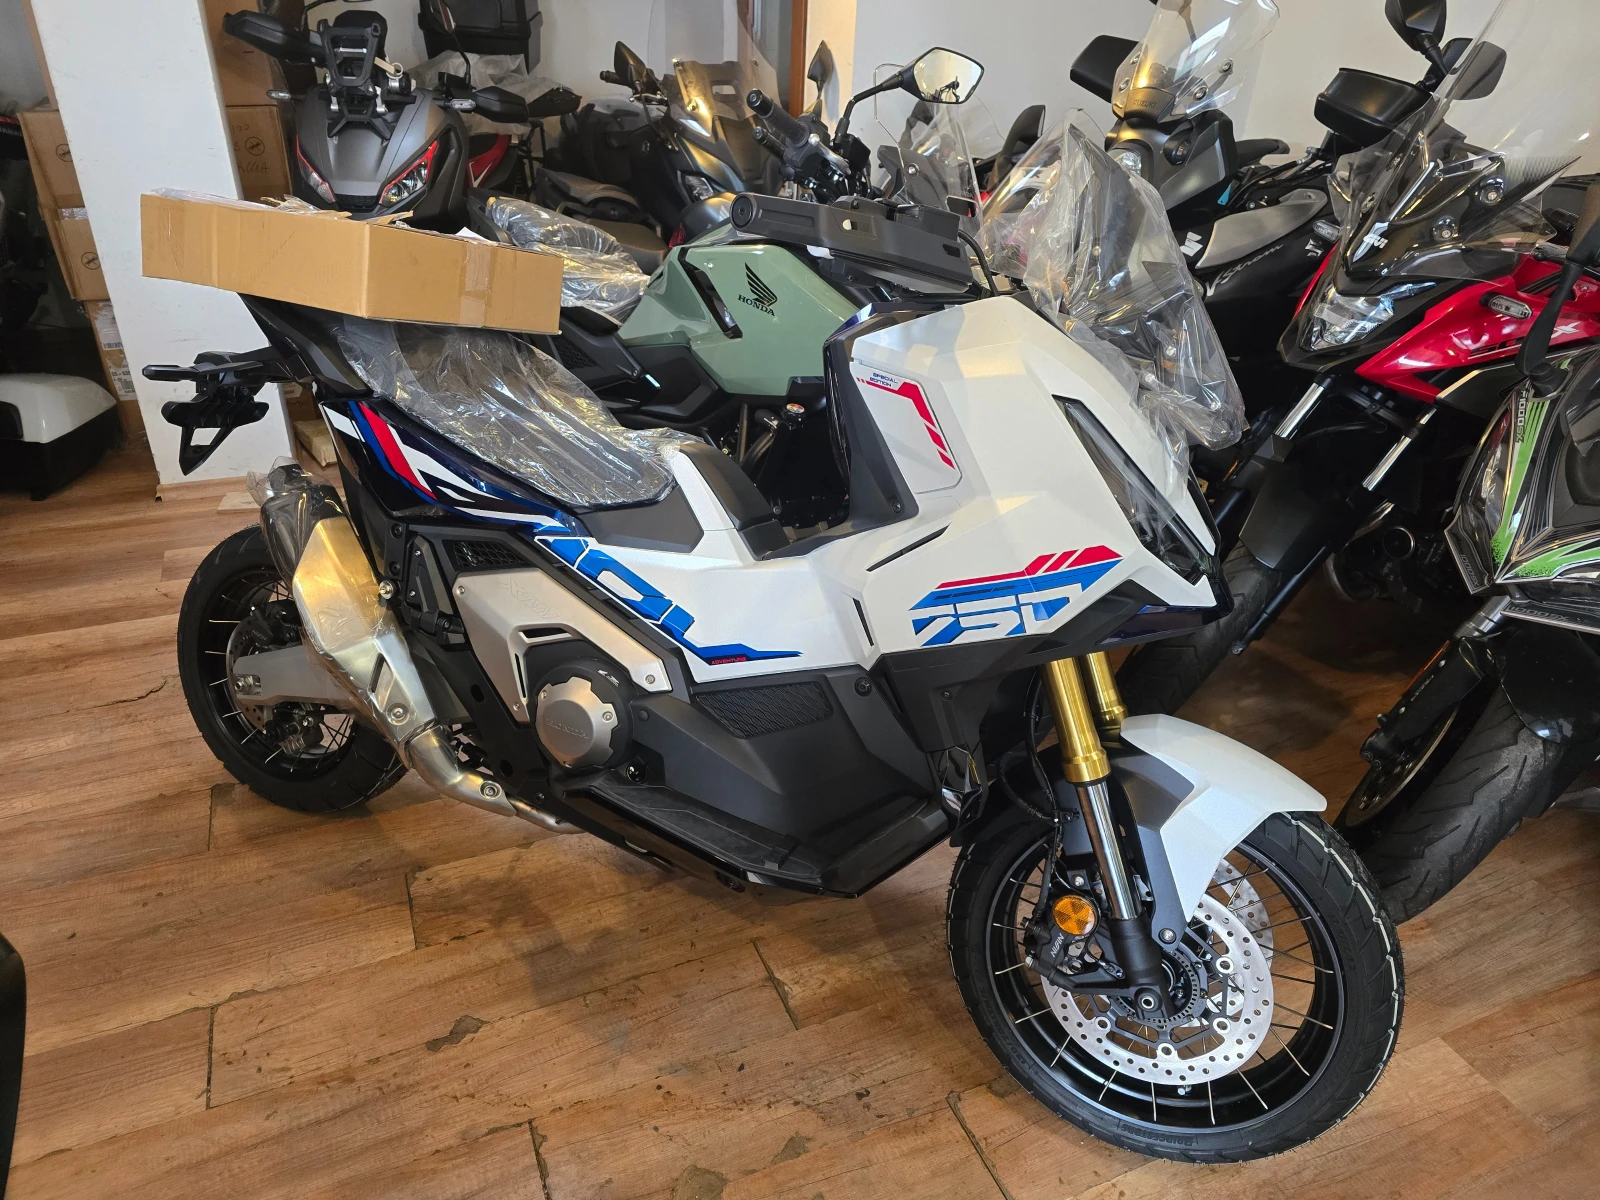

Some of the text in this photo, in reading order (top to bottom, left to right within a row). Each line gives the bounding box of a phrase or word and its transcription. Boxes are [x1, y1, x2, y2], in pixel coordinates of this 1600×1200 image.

[1132, 100, 1157, 108] SUZUKI
[738, 294, 775, 317] HONDA
[869, 376, 892, 387] EDITION
[872, 372, 899, 385] SPECIAL
[711, 656, 747, 665] ADVENTURE
